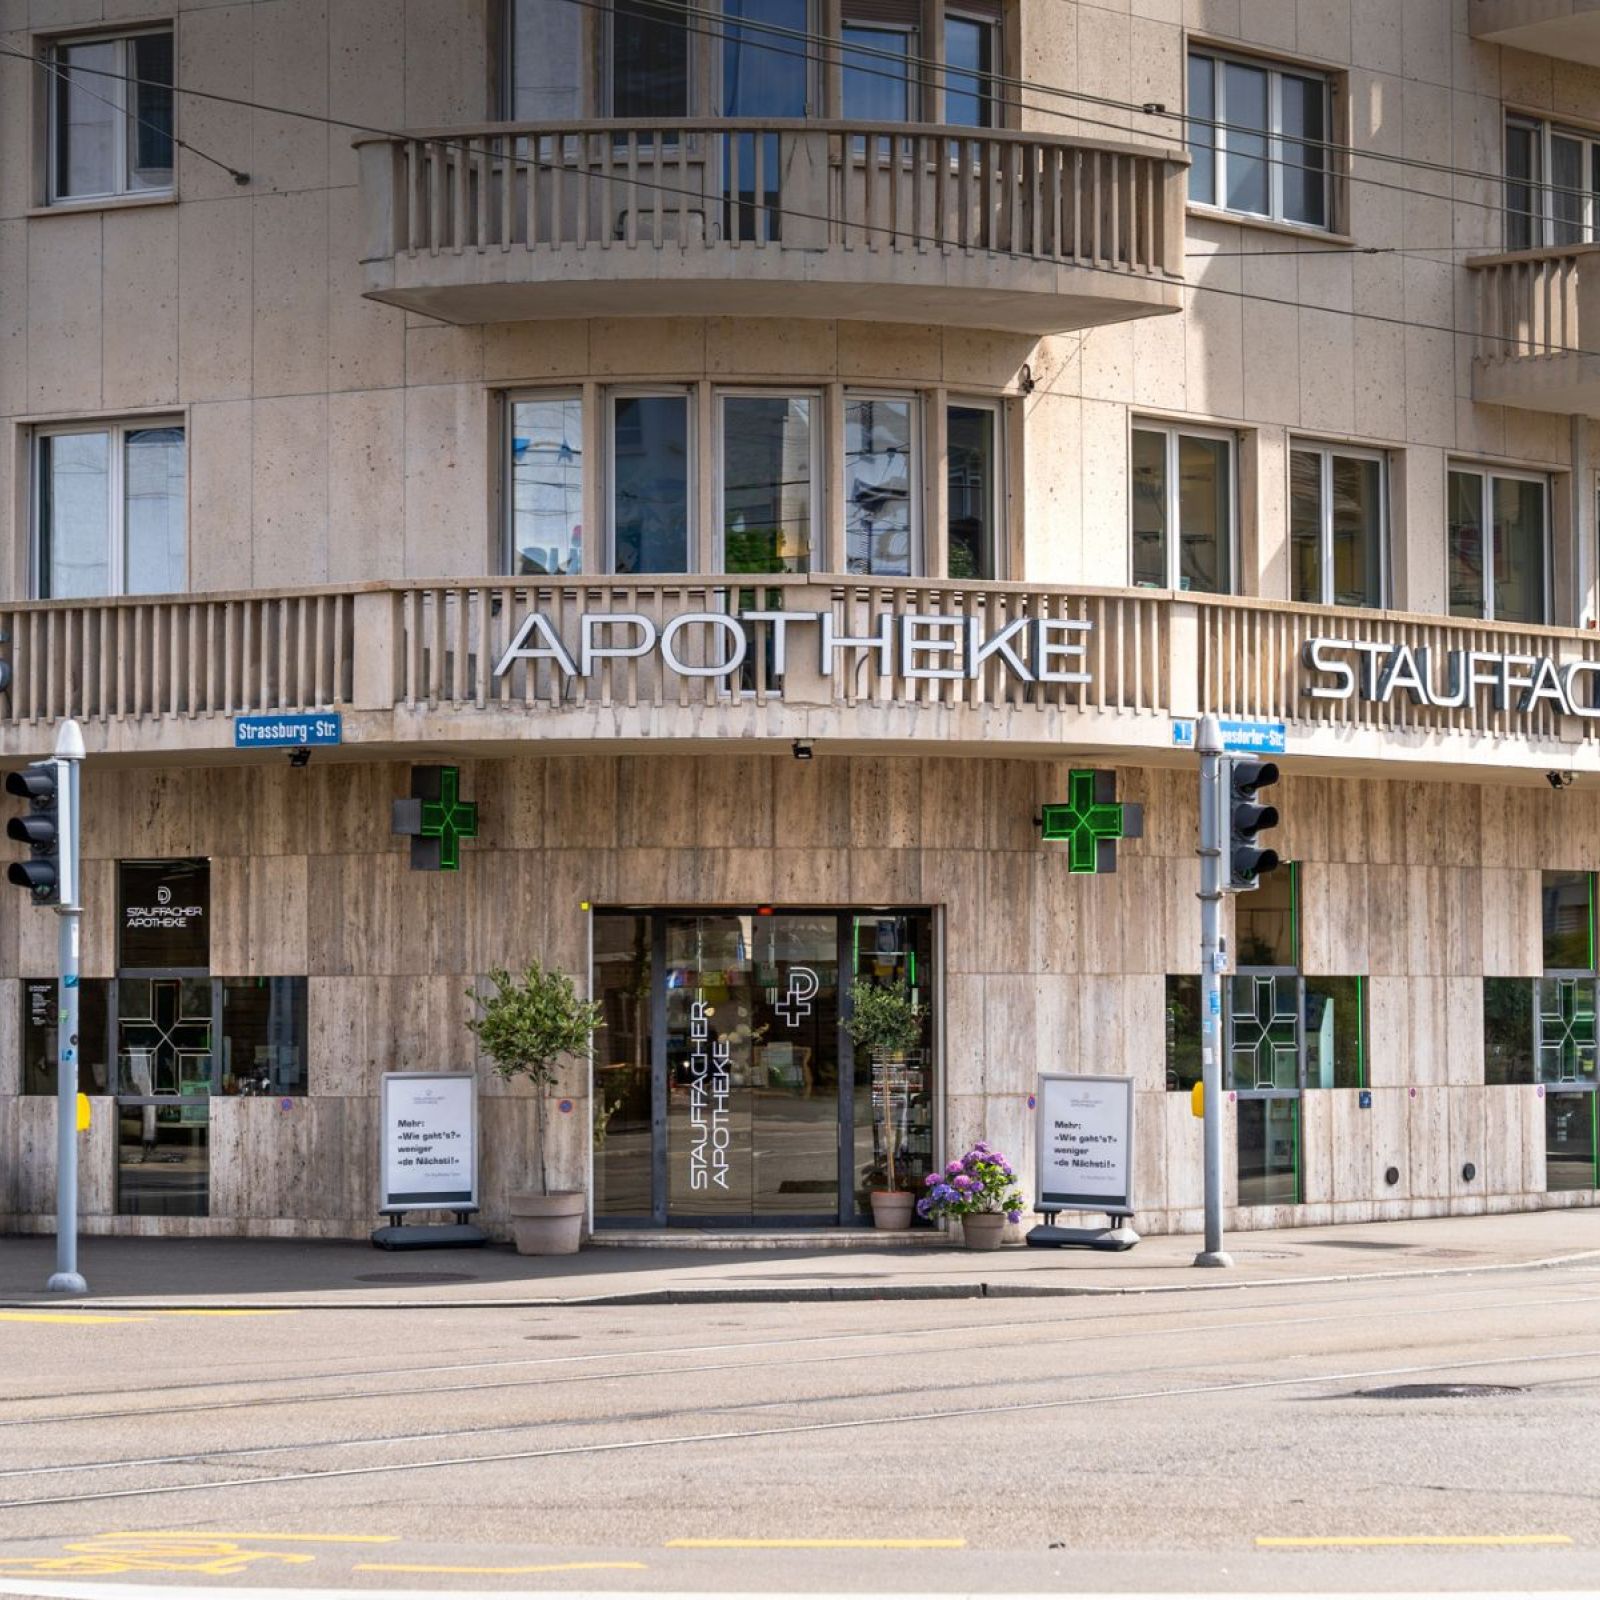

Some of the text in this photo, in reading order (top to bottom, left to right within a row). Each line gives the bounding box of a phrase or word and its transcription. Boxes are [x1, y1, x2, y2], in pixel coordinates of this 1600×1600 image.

[493, 611, 1093, 683] APOTHEKE
[126, 906, 203, 917] STAUFFACHER
[126, 917, 187, 928] APOTHEKE
[691, 1001, 708, 1190] STAUFFACHER
[713, 1040, 730, 1189] APOTHEKE
[397, 1119, 425, 1128] Mehr:
[1054, 1120, 1082, 1129] Mehr:
[397, 1145, 433, 1154] weniger
[1054, 1147, 1089, 1156] weniger
